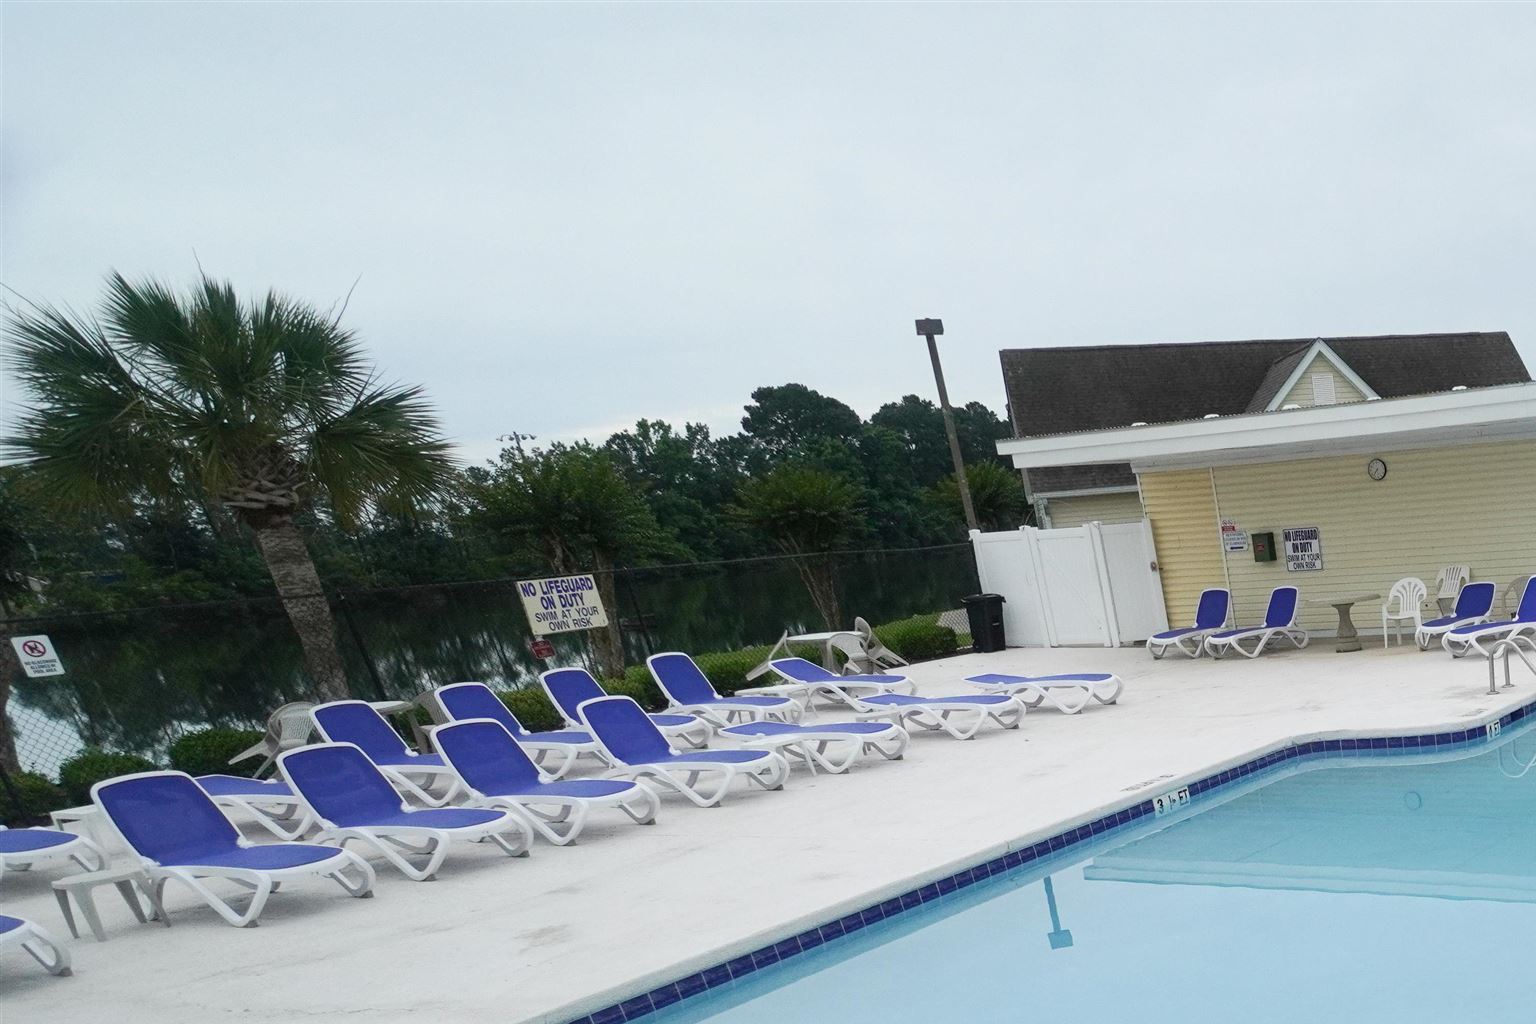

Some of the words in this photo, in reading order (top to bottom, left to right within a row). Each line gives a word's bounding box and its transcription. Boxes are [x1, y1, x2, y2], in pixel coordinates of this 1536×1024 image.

[1284, 531, 1291, 541] NO
[1291, 529, 1317, 541] LIFEGUARD
[1292, 543, 1299, 553] ON
[1300, 542, 1312, 553] DUTY
[1288, 554, 1299, 562] SWIM
[1307, 553, 1320, 561] YOUR
[520, 582, 537, 597] NO
[539, 576, 593, 595] LIFEGUARD
[540, 596, 556, 610] ON
[558, 592, 585, 608] DUTY
[535, 611, 558, 622] SWIM
[561, 609, 572, 619] AT
[575, 606, 599, 617] YOUR
[549, 620, 570, 631] OWN
[572, 617, 593, 628] RISK
